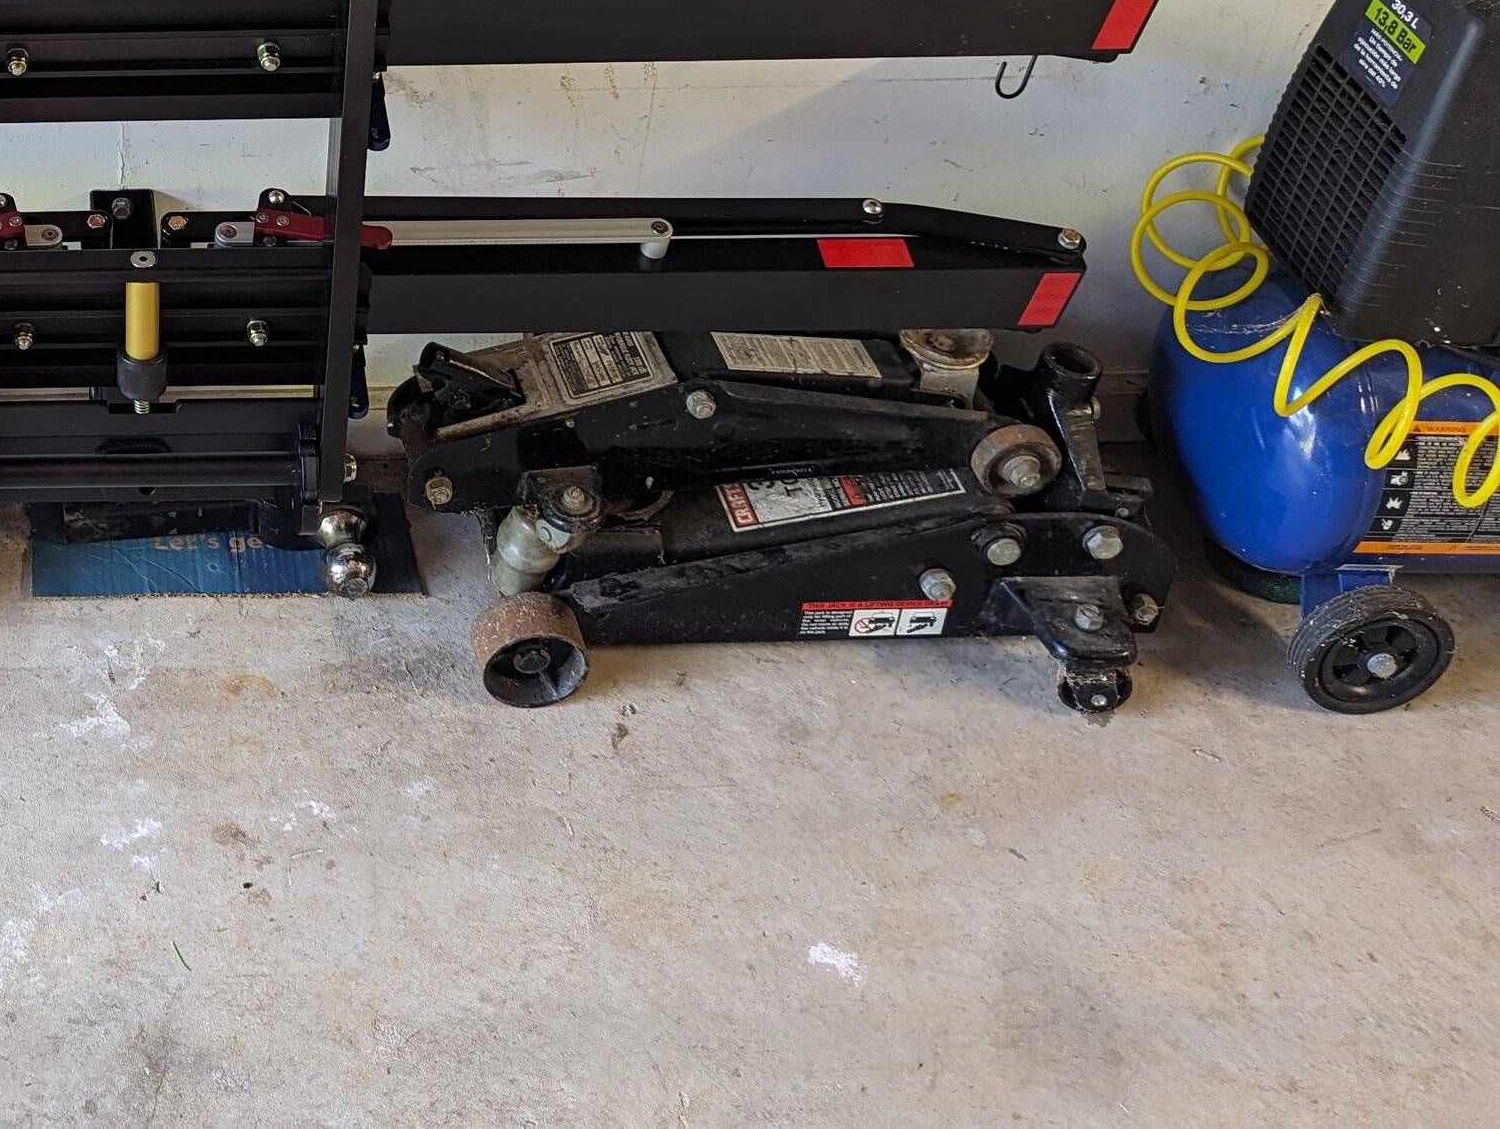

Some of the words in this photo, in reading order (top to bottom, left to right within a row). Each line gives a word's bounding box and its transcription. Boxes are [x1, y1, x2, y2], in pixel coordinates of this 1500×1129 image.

[1373, 7, 1399, 35] 13,8
[1396, 30, 1417, 54] Bar
[1391, 0, 1414, 22] 30,3
[1411, 17, 1419, 30] L
[722, 483, 757, 526] CRAFT
[153, 534, 220, 550] Let's
[229, 536, 265, 553] ge
